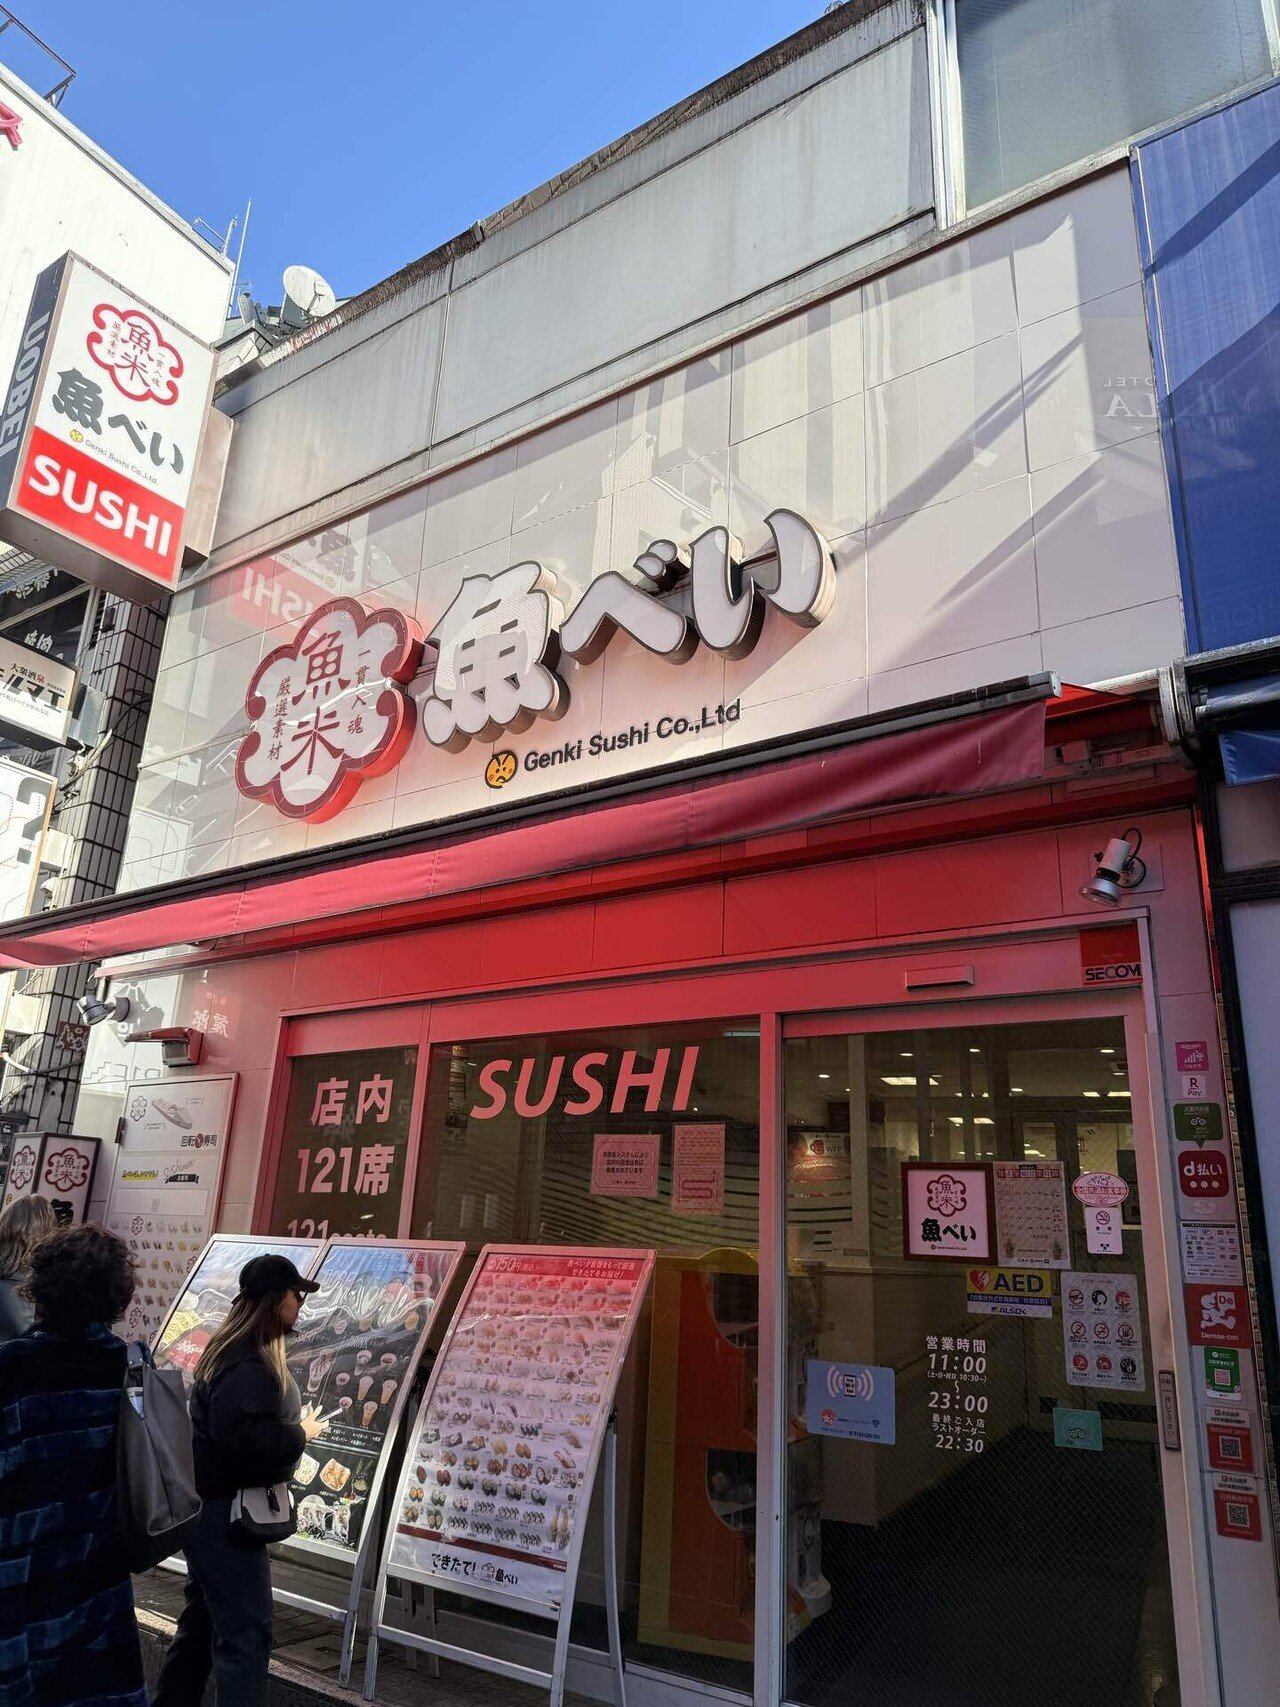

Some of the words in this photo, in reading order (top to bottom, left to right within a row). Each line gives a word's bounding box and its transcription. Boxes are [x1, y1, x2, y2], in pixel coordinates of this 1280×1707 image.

[53, 368, 184, 474] 魚べい
[85, 439, 107, 456] Genki
[108, 452, 130, 469] Sushi
[29, 455, 172, 555] SUSHI
[422, 508, 832, 750] 魚べい
[281, 630, 350, 775] 魚米
[524, 738, 582, 773] Genki
[589, 723, 648, 756] Sushi
[657, 699, 741, 740] Co.,Ltd
[470, 1046, 699, 1119] SUSHI
[1190, 1077, 1198, 1088] R
[310, 1074, 393, 1126] 店内
[298, 1143, 395, 1195] 121席
[1183, 1160, 1223, 1177] d払い
[921, 1218, 976, 1242] 魚べい
[993, 1272, 1044, 1292] AED
[1219, 1295, 1234, 1304] De
[999, 1307, 1027, 1315] ALSOK
[926, 1335, 986, 1353] 営業時間
[929, 1353, 987, 1373] 11:00
[928, 1391, 988, 1413] 23:00
[932, 1413, 985, 1428] 最終ご入店
[932, 1423, 986, 1436] ラストオーダー
[935, 1434, 984, 1453] 22:30
[495, 1568, 518, 1585] 魚べい
